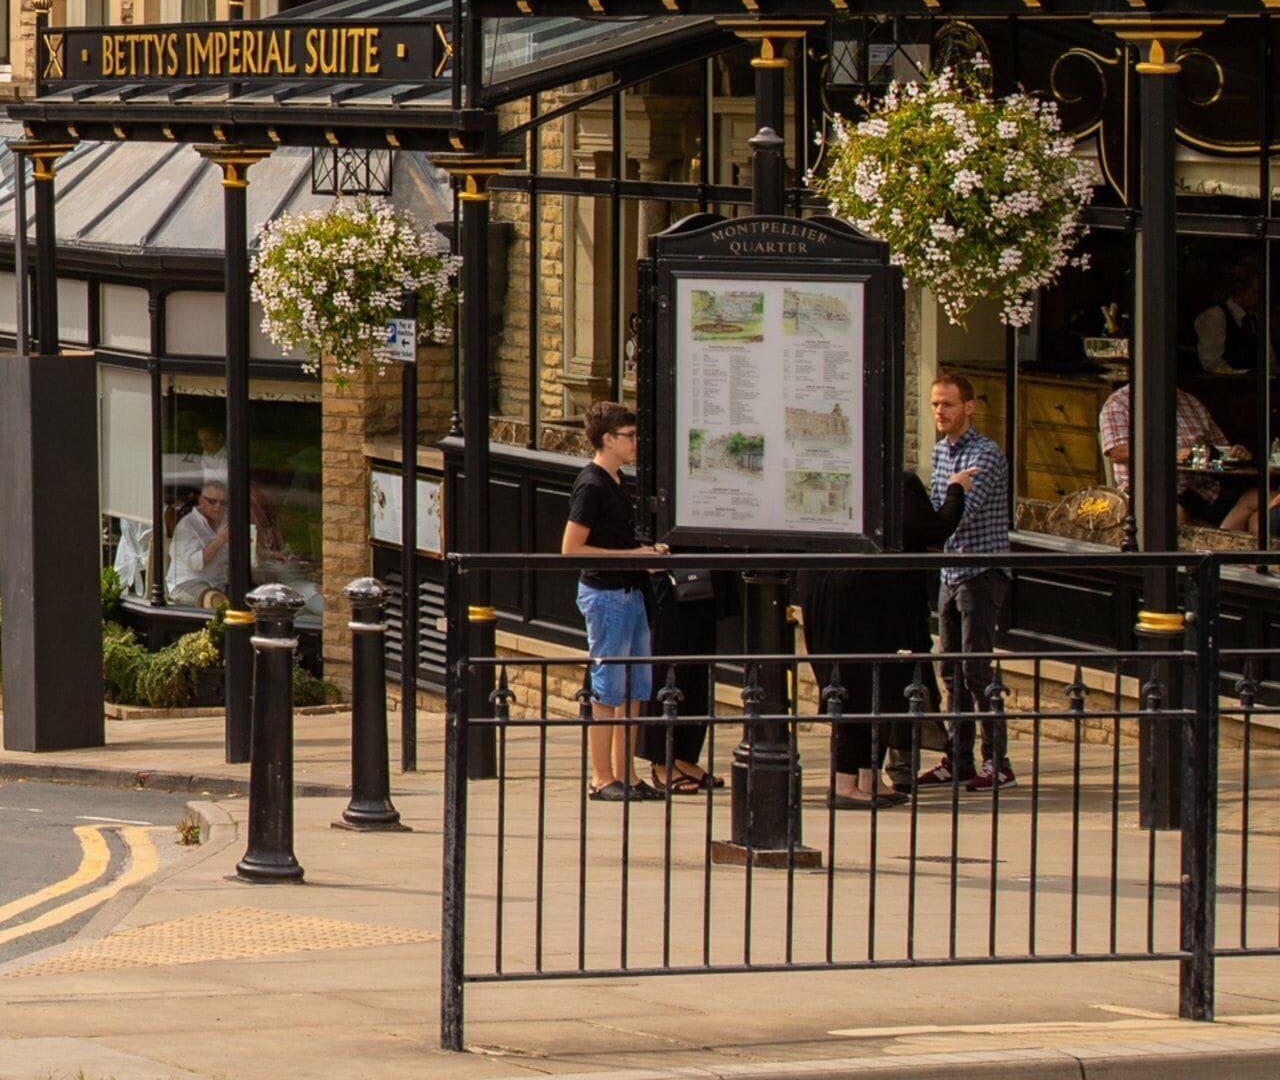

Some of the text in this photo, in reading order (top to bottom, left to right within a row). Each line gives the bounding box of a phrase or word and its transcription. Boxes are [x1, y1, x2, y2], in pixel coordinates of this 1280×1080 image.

[101, 27, 380, 76] BETTYS IMPERIAL SUITE
[711, 221, 828, 245] MONTPELLIER
[729, 241, 808, 256] QUARTER
